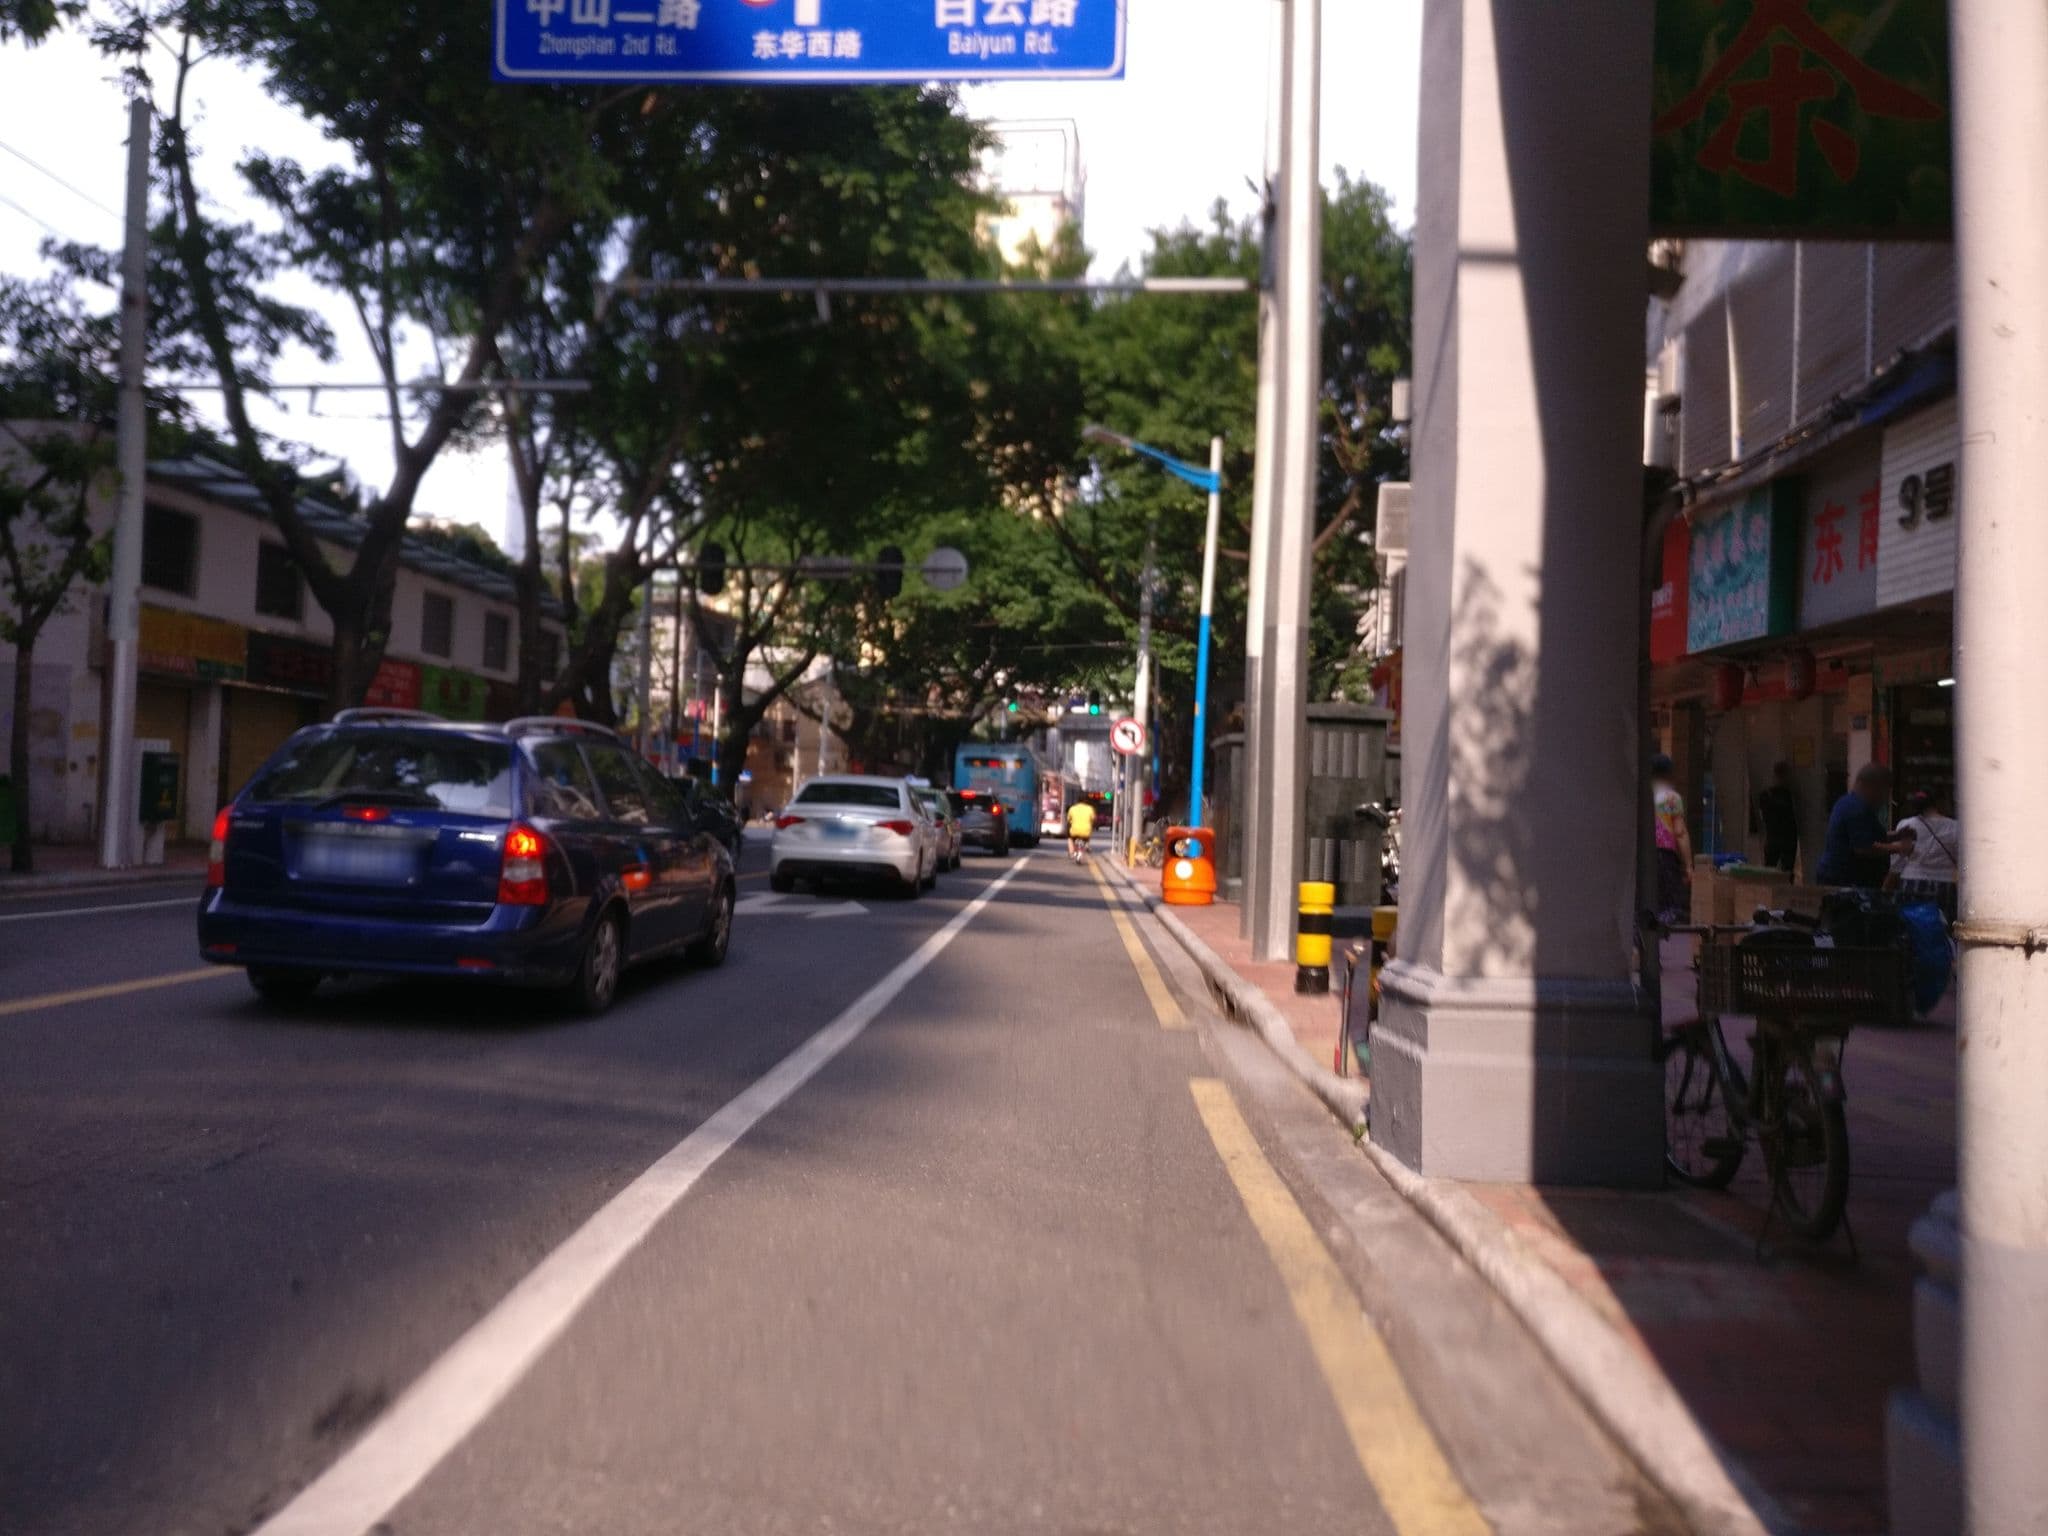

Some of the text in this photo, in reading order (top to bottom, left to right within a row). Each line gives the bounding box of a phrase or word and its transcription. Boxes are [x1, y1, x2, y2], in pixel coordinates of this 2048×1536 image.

[935, 0, 1079, 28] 白云路
[538, 32, 616, 59] Zhongshan
[621, 33, 650, 56] 2nd
[752, 30, 862, 59] 东华西路
[948, 31, 1059, 60] Baiyun Rd.
